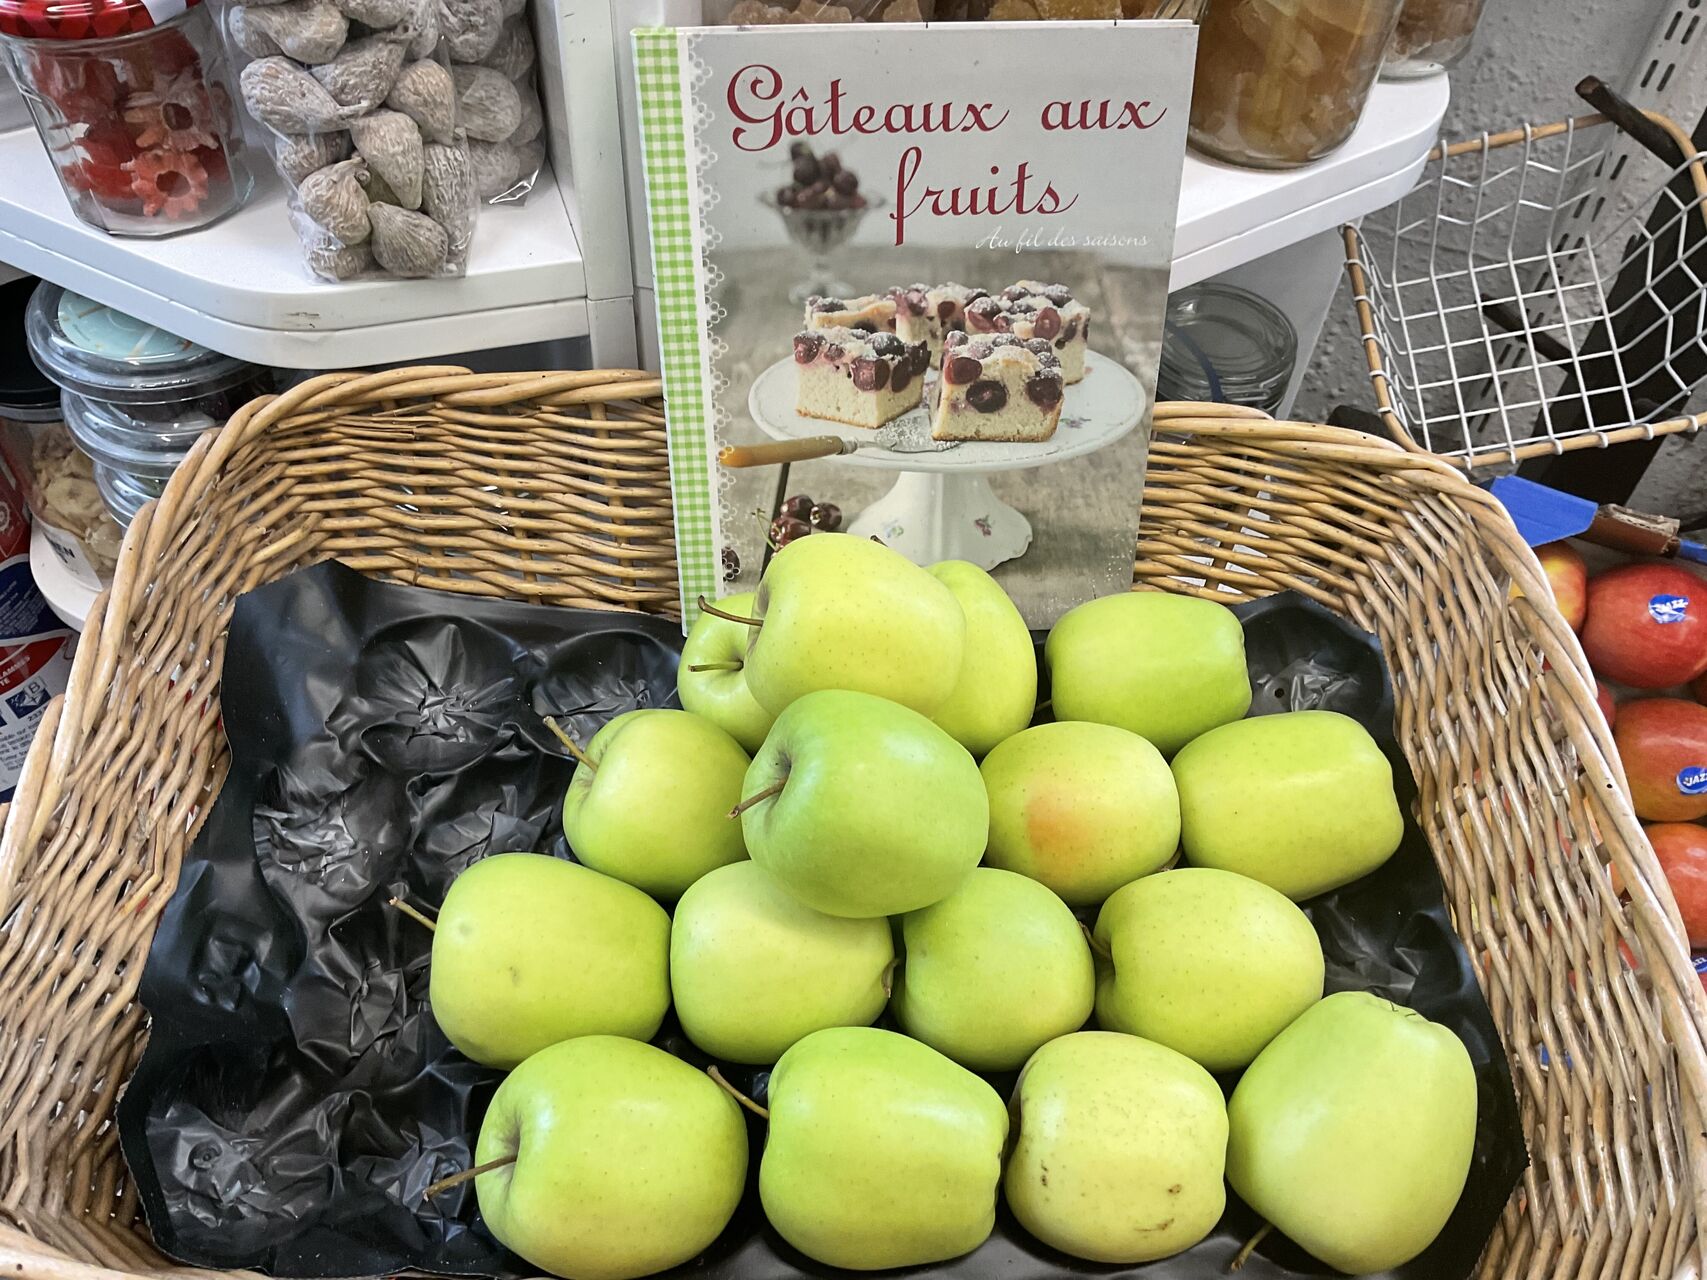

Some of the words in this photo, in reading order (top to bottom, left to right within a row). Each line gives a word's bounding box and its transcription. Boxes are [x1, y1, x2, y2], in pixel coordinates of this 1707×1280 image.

[726, 63, 1010, 152] Gâteaux
[1041, 96, 1168, 131] aux
[889, 145, 1080, 247] fruits
[975, 225, 1011, 250] Au
[1014, 227, 1044, 255] fil
[1047, 226, 1077, 248] des
[1082, 233, 1150, 248] saisons
